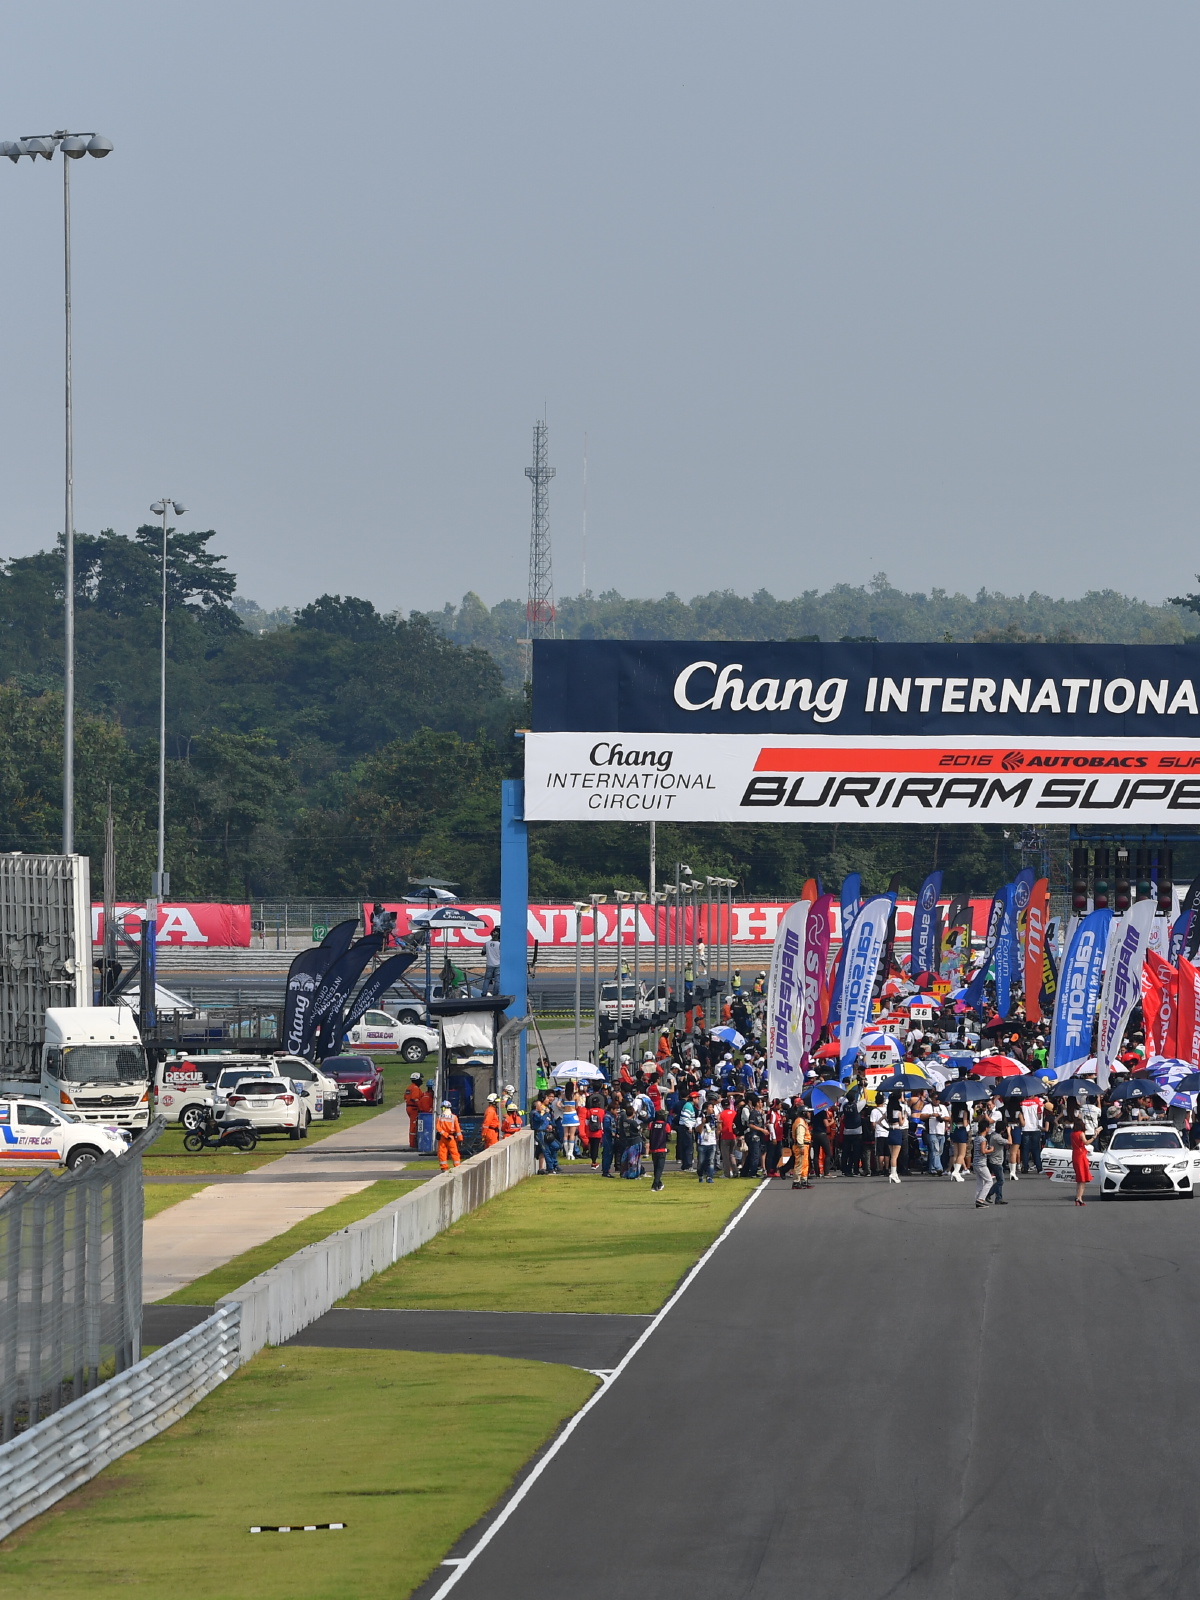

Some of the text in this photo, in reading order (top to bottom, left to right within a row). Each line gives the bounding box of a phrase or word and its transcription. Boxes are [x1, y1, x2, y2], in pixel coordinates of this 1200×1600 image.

[673, 660, 848, 722] Chang
[589, 742, 674, 770] Chang
[938, 755, 994, 767] 2016
[1026, 756, 1149, 769] AUTOBACS
[546, 773, 717, 790] INTERNATIONAL
[740, 777, 1034, 809] BURIRAM
[588, 794, 676, 809] CIRCUIT
[315, 928, 325, 936] 12
[1028, 907, 1042, 963] au
[806, 949, 819, 974] S
[287, 995, 310, 1055] Chang
[882, 1025, 895, 1033] 38
[871, 1051, 887, 1060] 46
[165, 1072, 204, 1083] RESCUE
[40, 1137, 53, 1145] CAR
